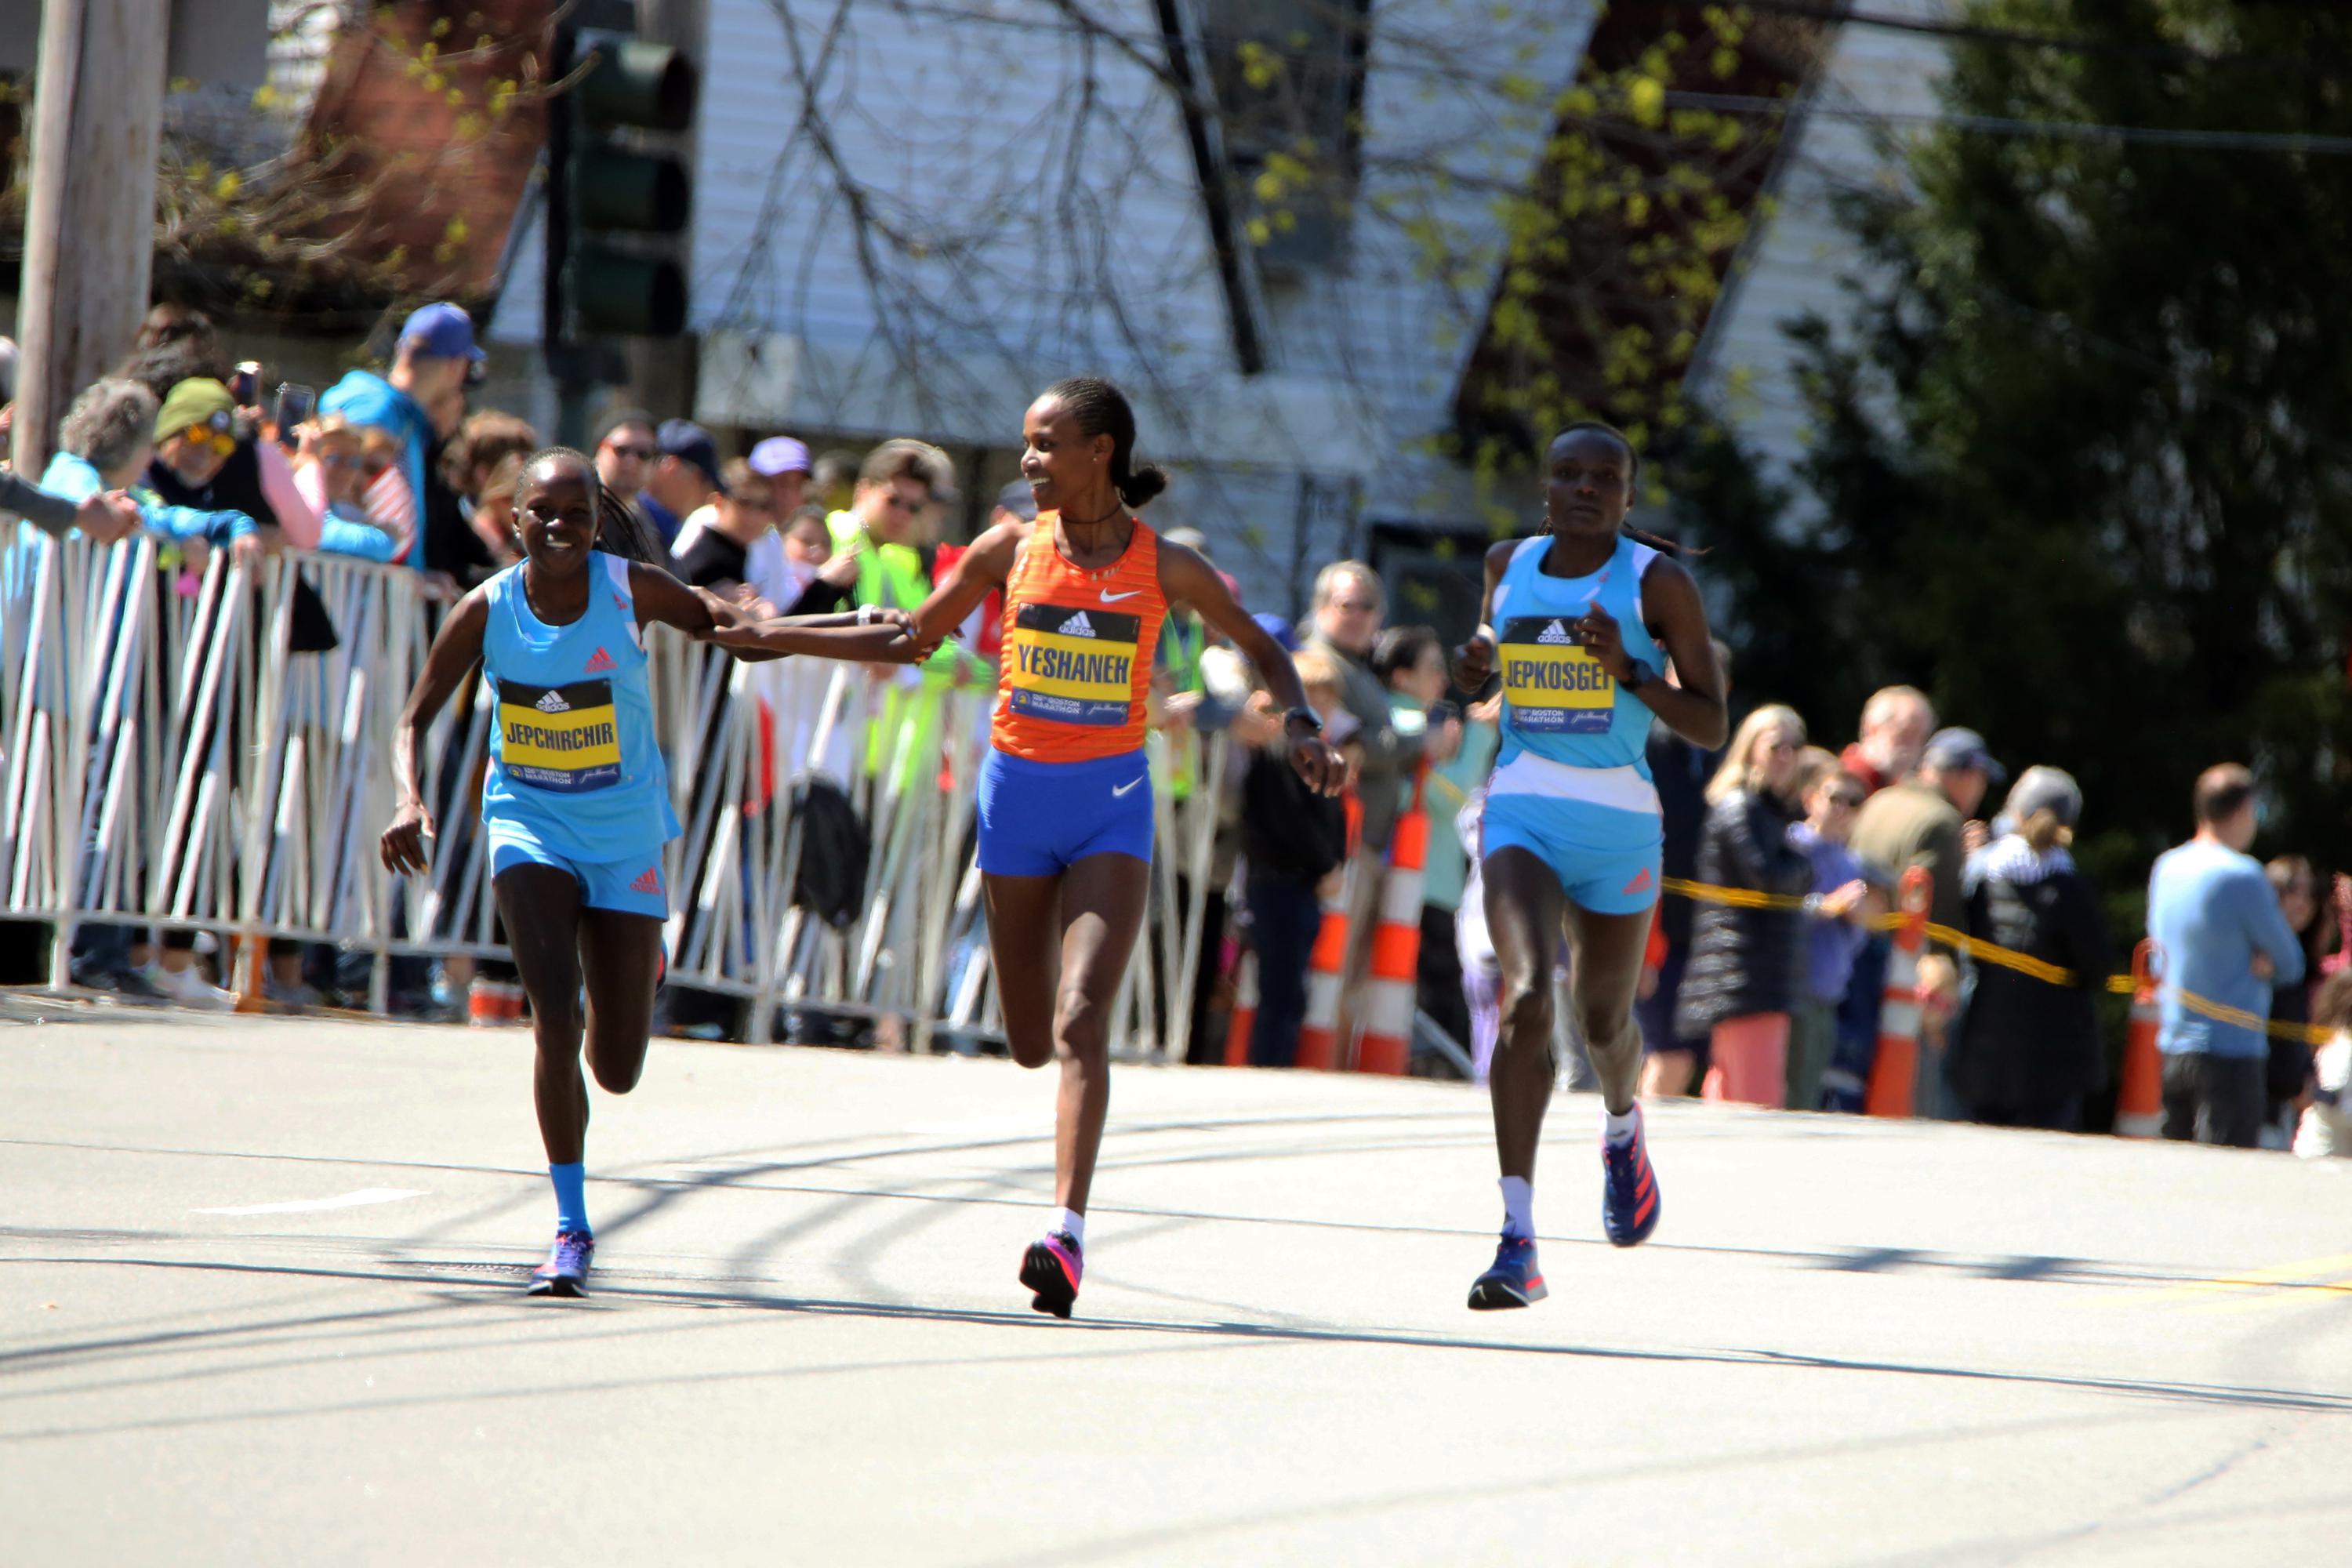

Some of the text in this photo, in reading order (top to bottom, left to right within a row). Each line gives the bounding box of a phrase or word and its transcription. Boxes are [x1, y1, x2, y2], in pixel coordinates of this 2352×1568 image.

[1058, 625, 1096, 637] adidas
[1537, 633, 1572, 644] adidas
[1018, 644, 1131, 684] YESHANEH
[1507, 660, 1610, 691] JEPKOSGEI
[535, 702, 571, 713] adidas
[506, 722, 614, 752] JEPCHIRCHIR
